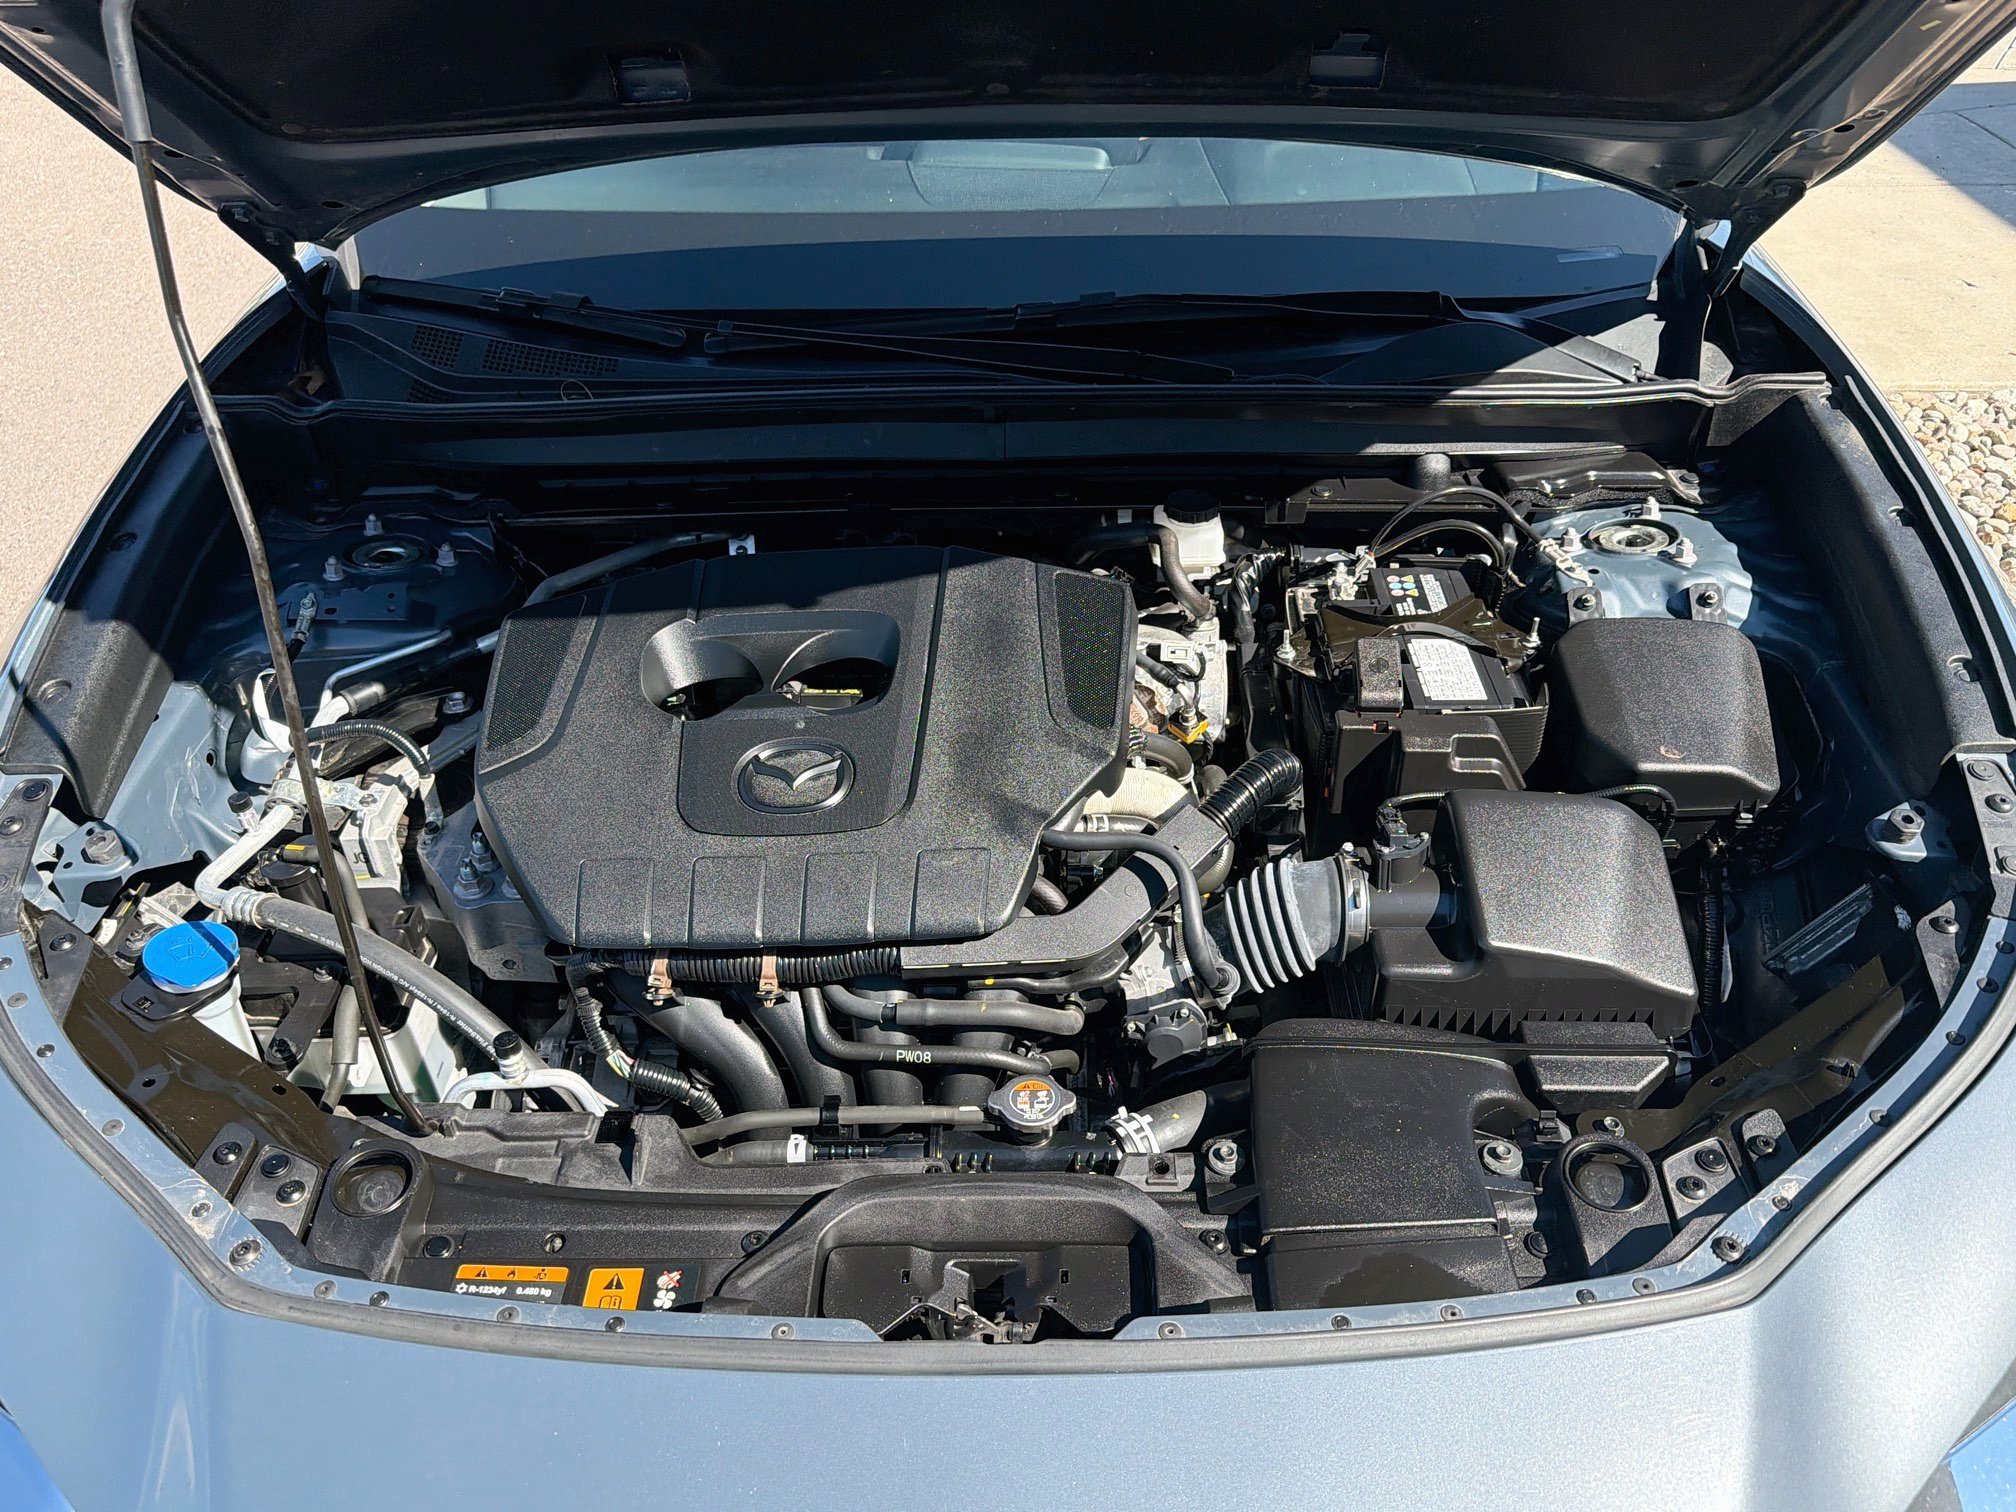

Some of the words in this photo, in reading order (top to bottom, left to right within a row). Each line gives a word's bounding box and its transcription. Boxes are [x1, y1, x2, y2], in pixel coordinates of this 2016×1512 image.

[373, 961, 399, 981] SUCTION
[896, 1049, 932, 1064] PW08
[468, 1285, 507, 1296] R-1234yf
[540, 1287, 552, 1297] kg
